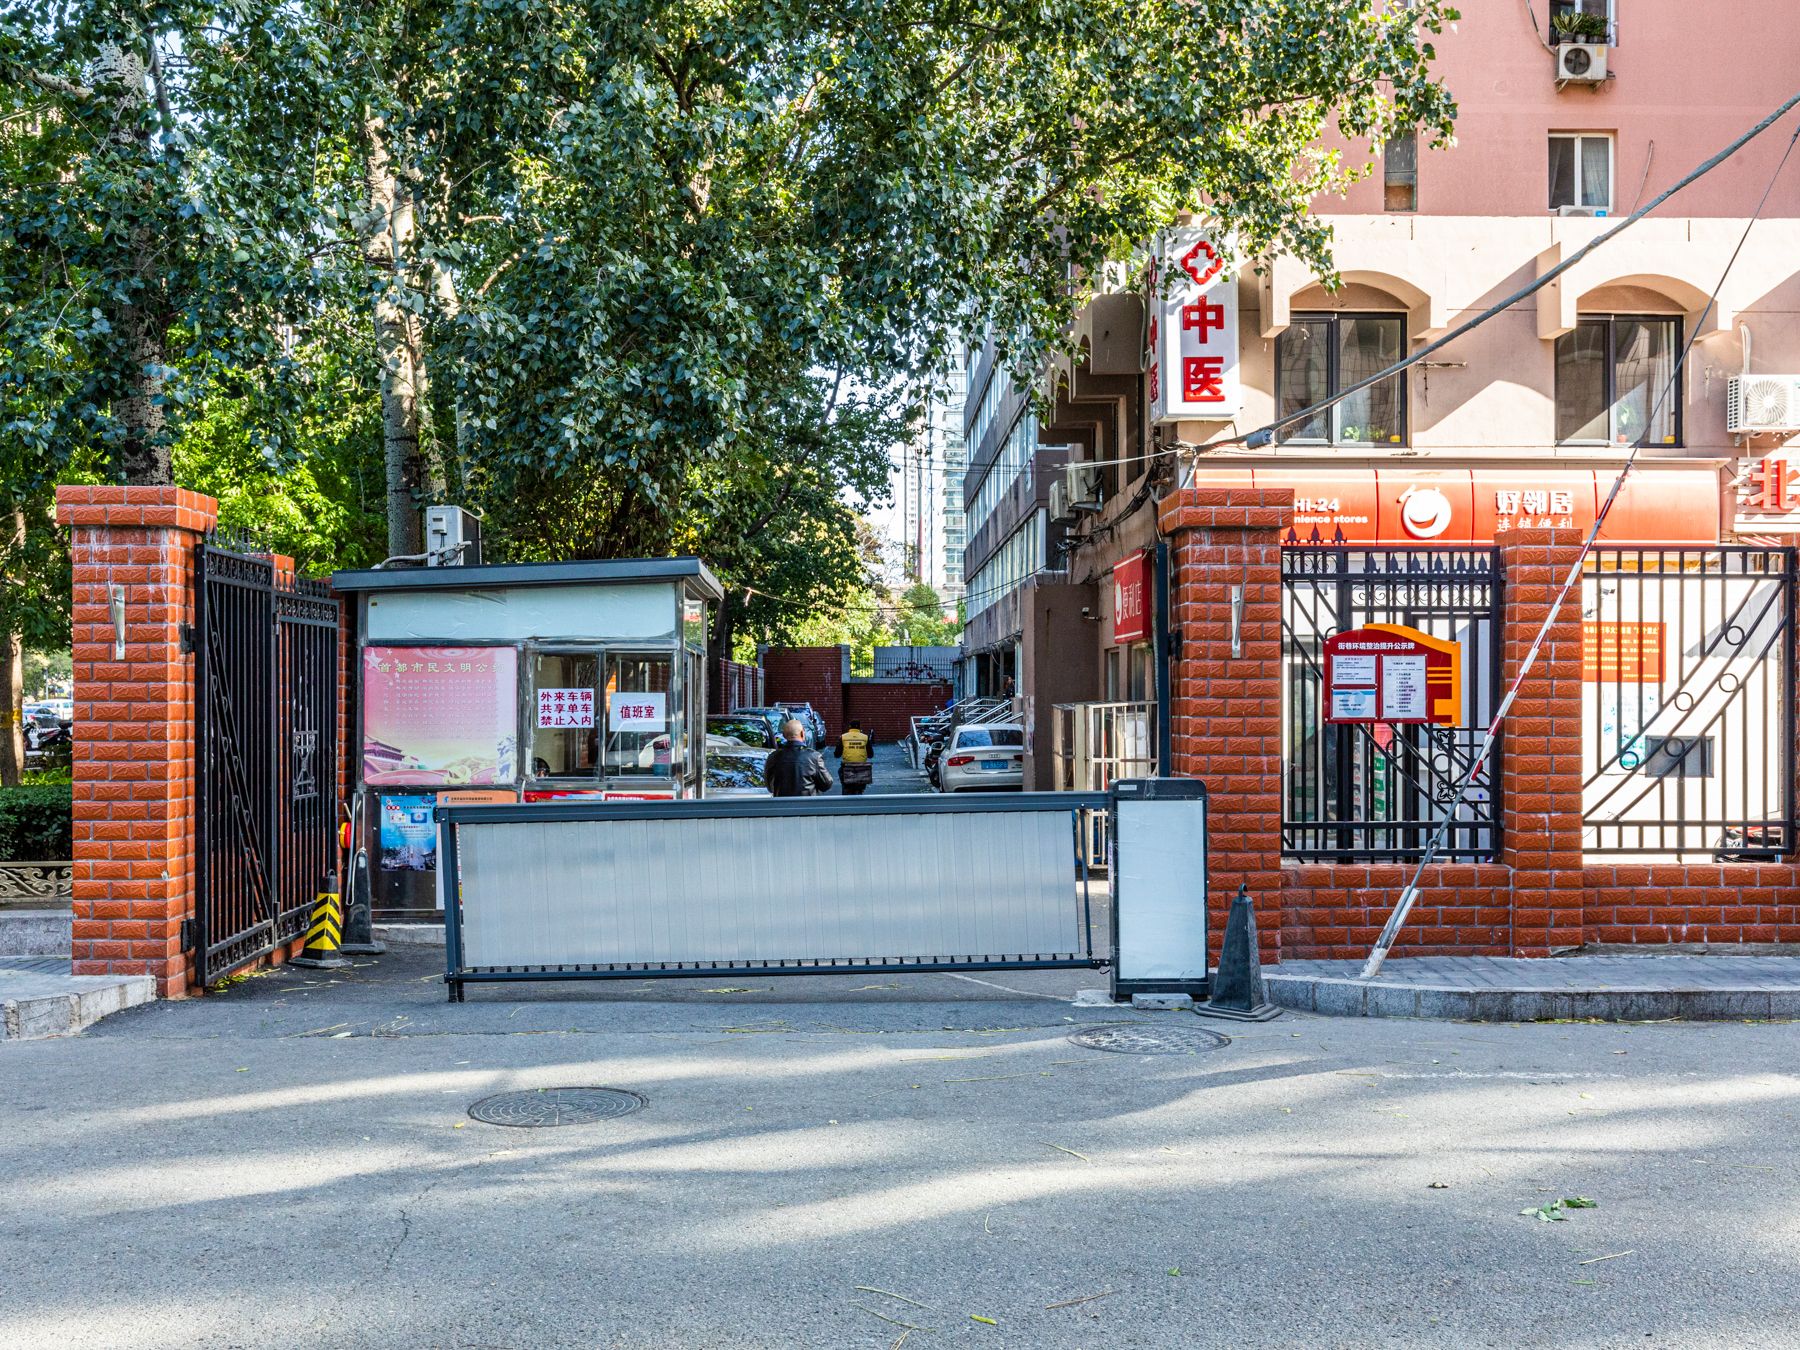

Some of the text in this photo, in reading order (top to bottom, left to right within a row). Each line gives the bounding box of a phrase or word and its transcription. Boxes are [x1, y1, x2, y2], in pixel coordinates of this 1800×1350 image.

[1183, 295, 1225, 402] 中医
[1496, 490, 1573, 515] 好邻居
[1333, 515, 1368, 523] stores
[1338, 642, 1415, 650] 街巷环境整治提升公示牌
[540, 691, 592, 702] 外来车辆
[540, 703, 592, 714] 共享单车
[620, 705, 655, 719] 值班室
[540, 715, 592, 726] 禁止入内
